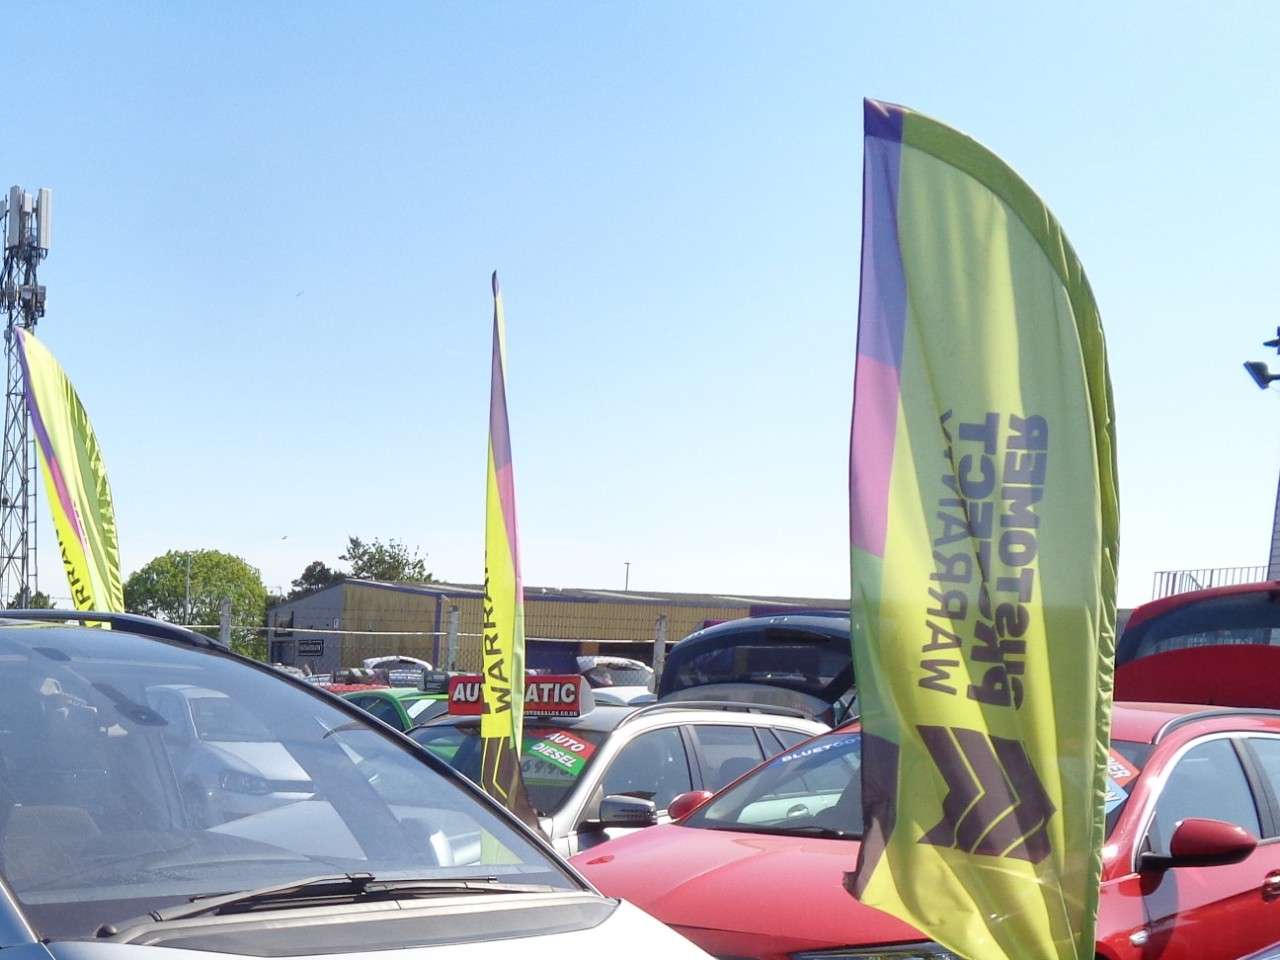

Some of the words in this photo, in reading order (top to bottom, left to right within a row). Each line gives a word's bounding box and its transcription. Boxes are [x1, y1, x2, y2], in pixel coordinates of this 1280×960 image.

[452, 682, 577, 703] AUATIC
[546, 732, 586, 752] AUTO
[531, 742, 577, 768] DIESEL
